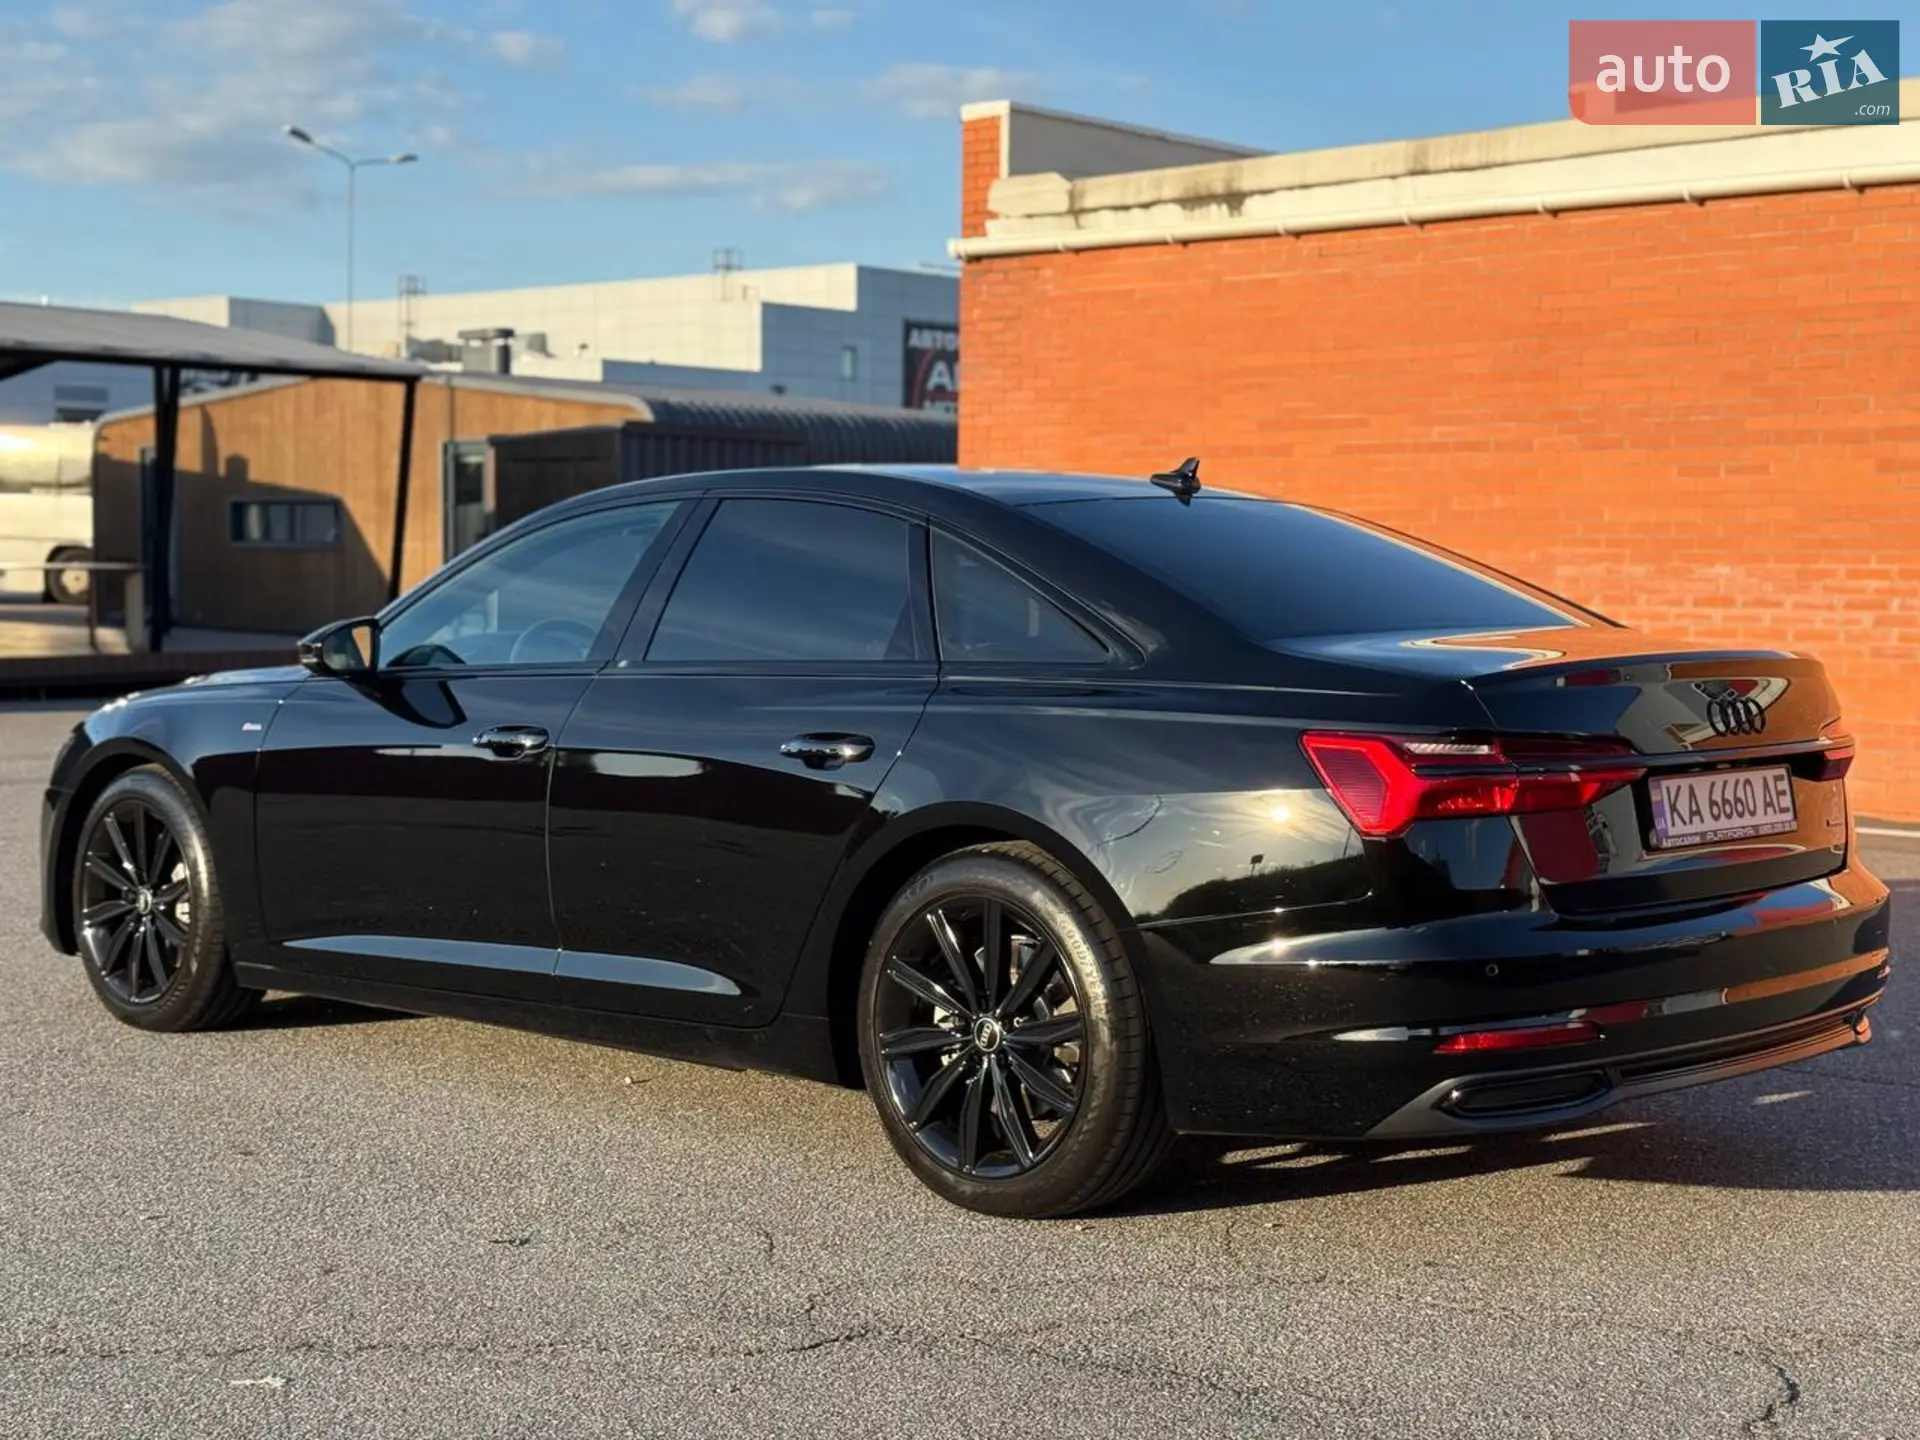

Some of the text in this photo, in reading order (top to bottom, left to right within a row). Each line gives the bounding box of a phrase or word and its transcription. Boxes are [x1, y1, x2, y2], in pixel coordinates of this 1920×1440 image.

[1665, 773, 1791, 828] KA 6660 AE
